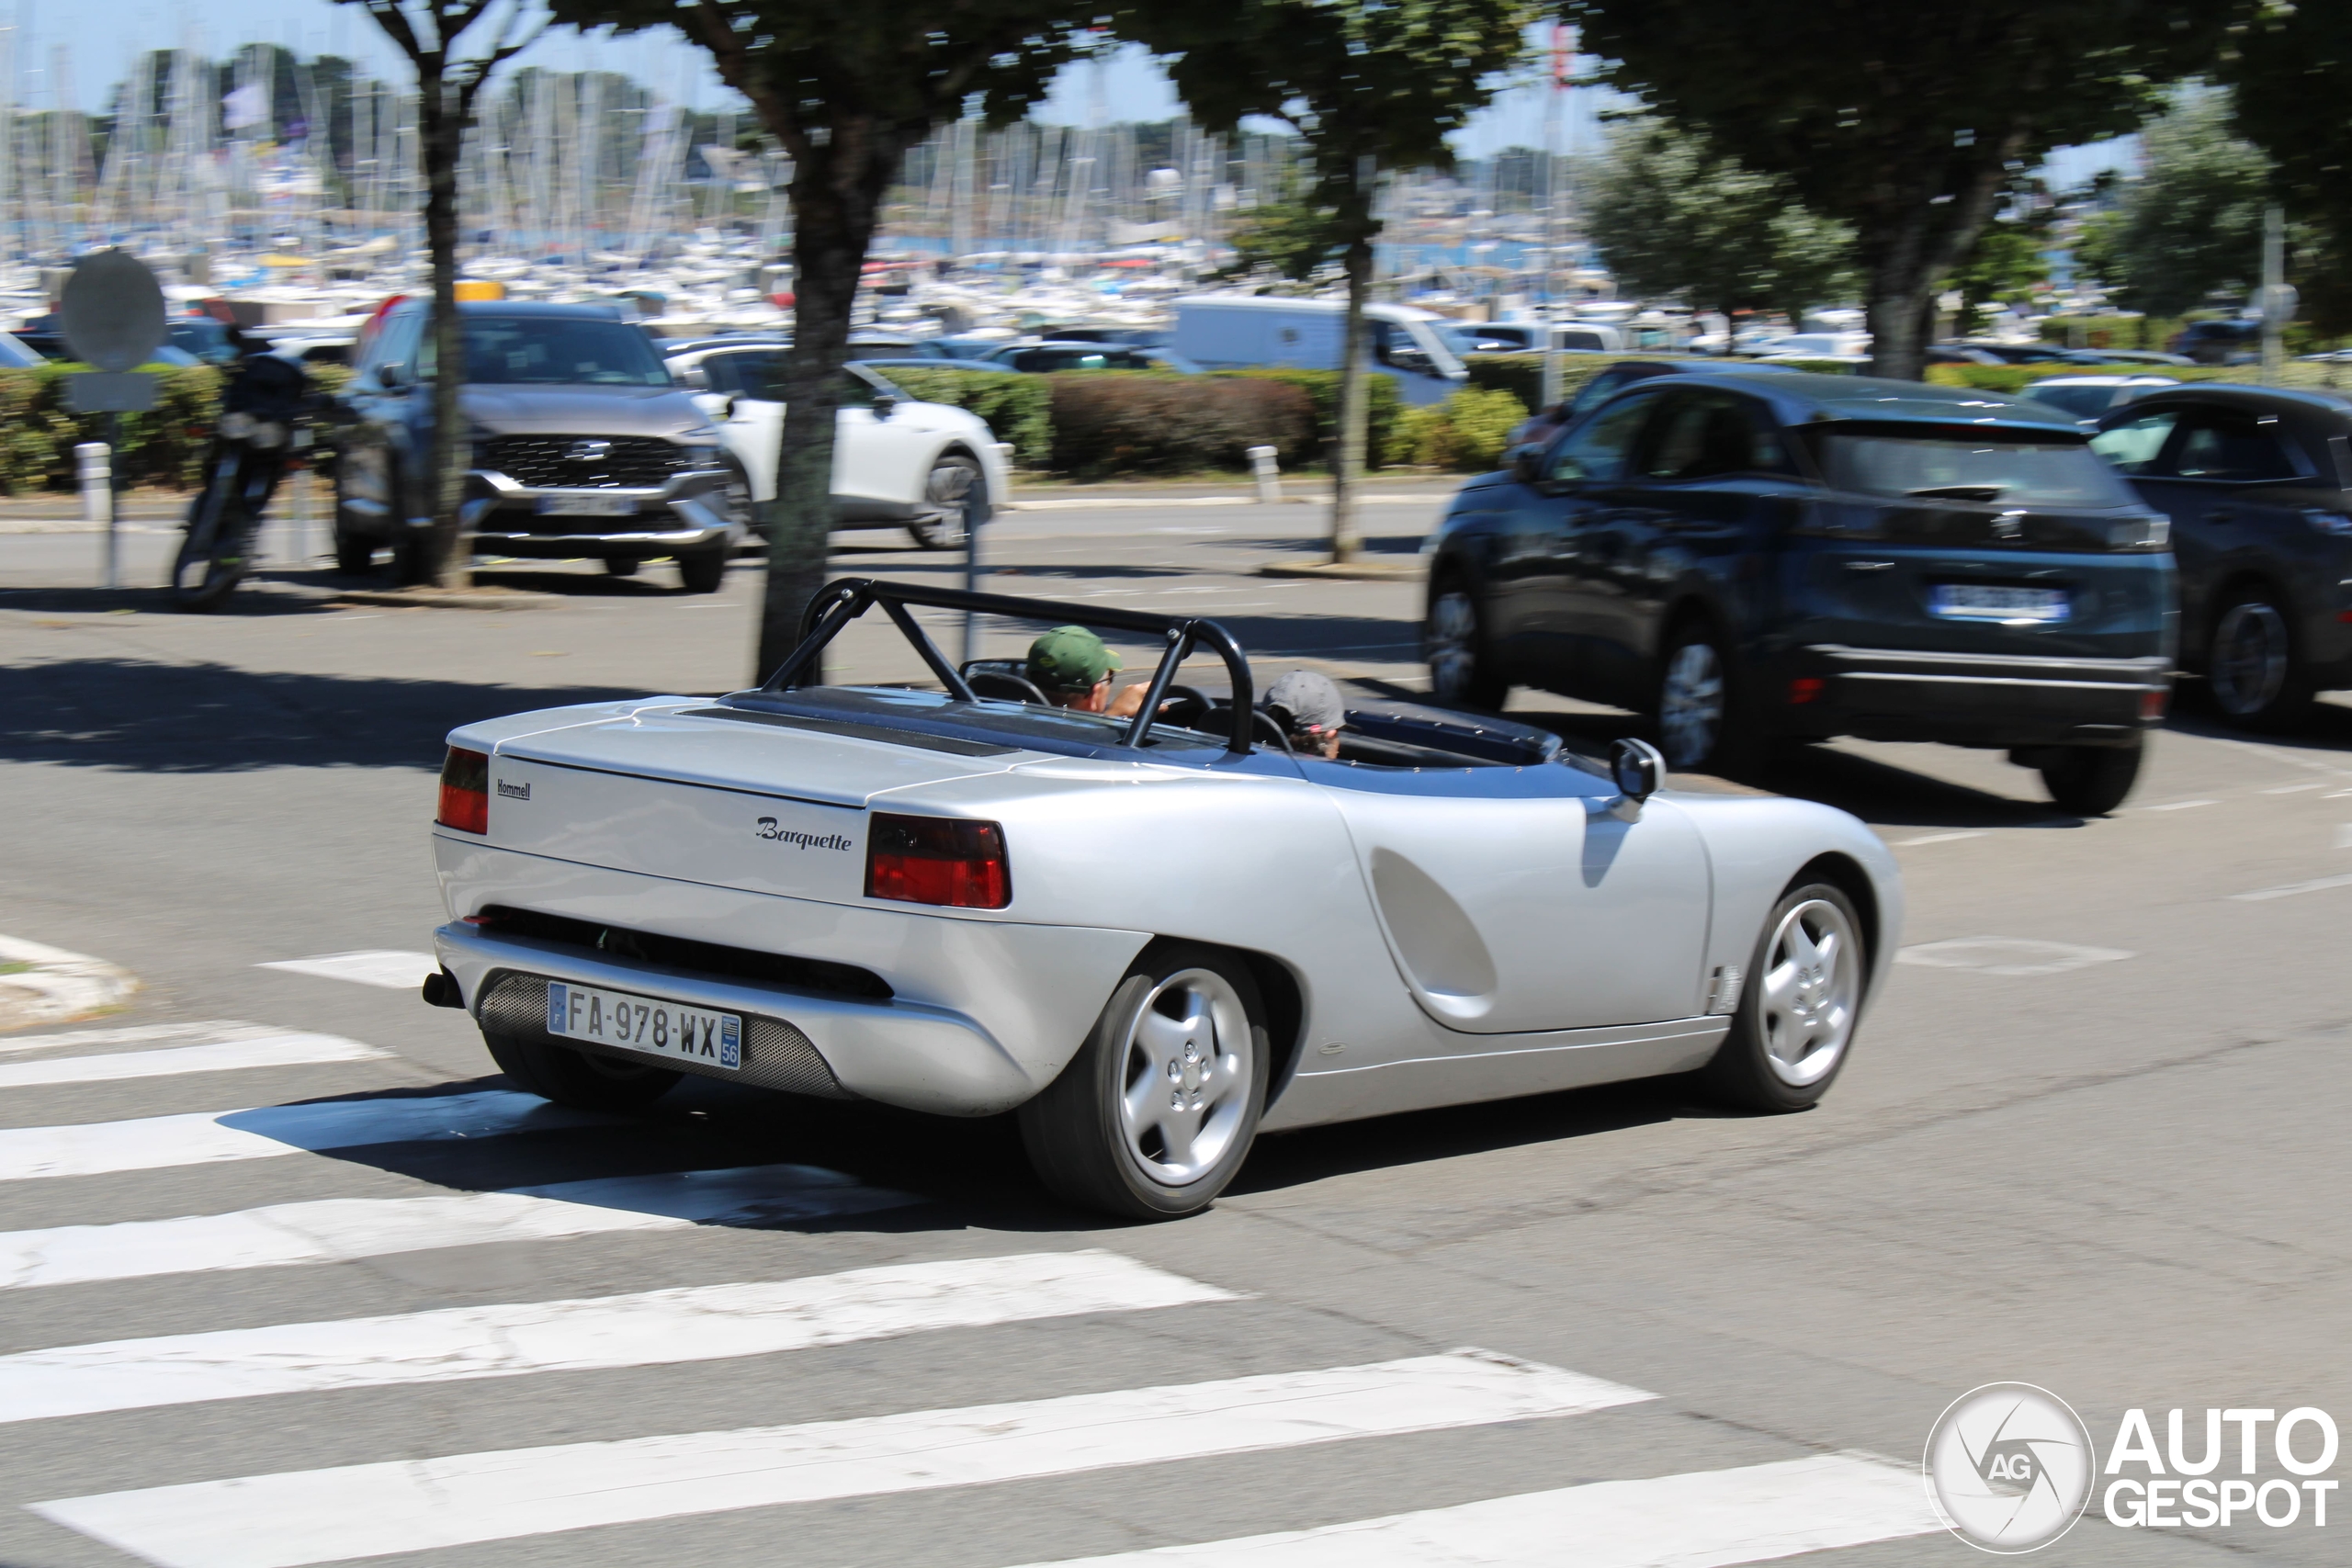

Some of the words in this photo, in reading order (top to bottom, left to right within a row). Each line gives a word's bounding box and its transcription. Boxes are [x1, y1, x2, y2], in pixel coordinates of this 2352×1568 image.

[498, 778, 531, 798] Hommell
[755, 817, 852, 851] Barquette
[554, 1013, 560, 1024] F
[569, 991, 716, 1058] FA-978-WX
[722, 1043, 738, 1063] 56
